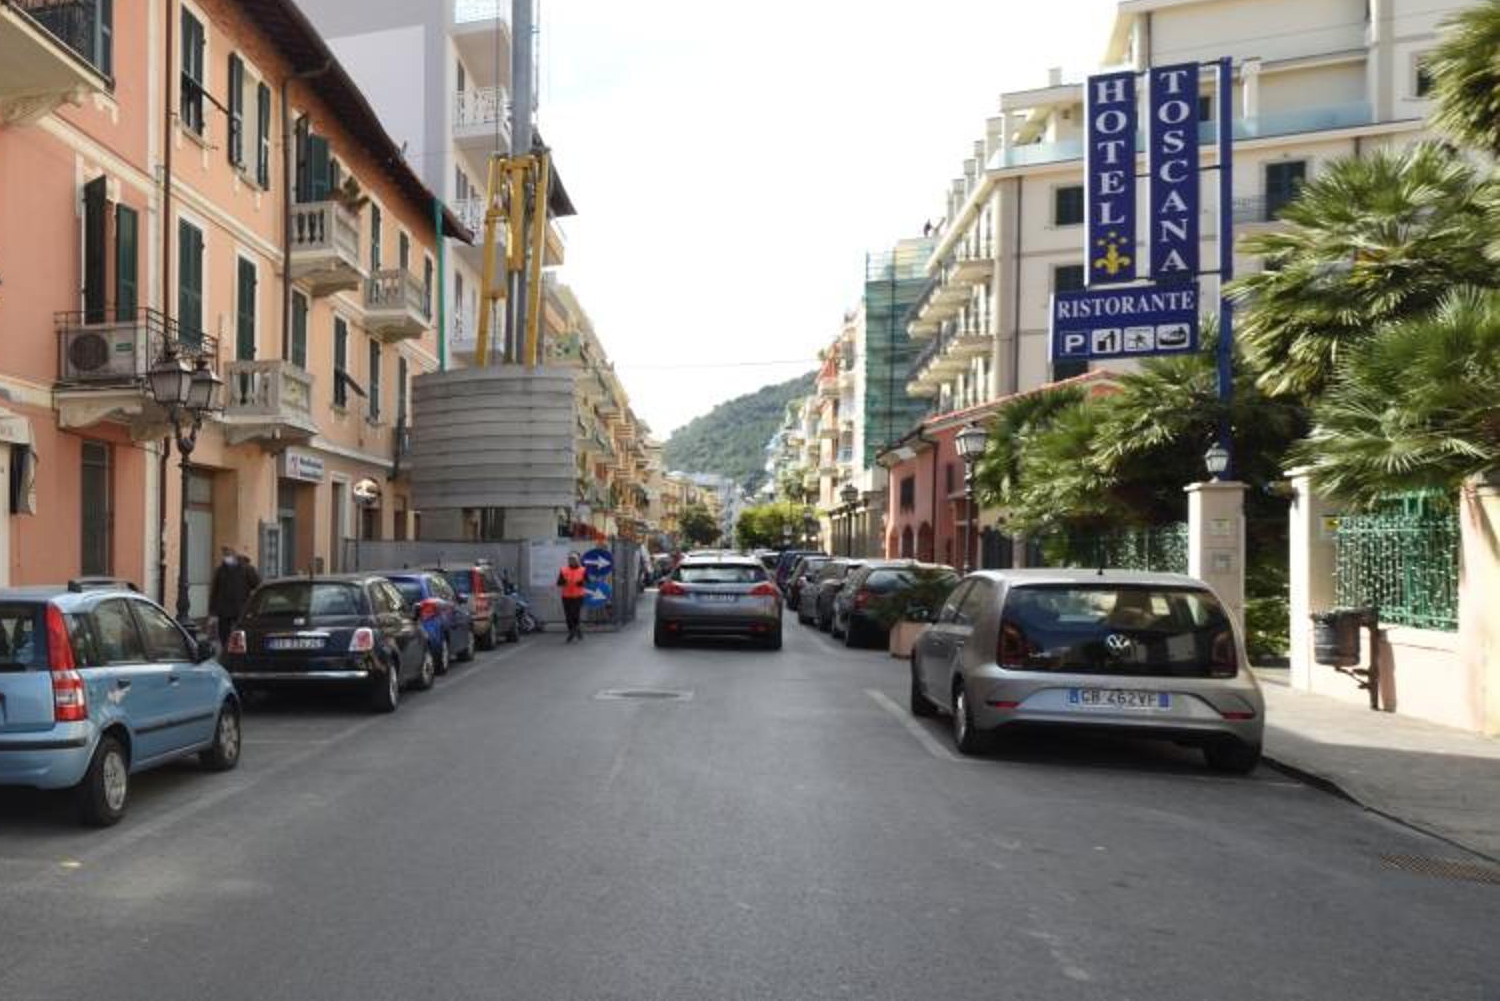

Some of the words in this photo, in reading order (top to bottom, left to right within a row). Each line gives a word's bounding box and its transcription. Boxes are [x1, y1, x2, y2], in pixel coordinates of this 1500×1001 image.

[1095, 77, 1128, 225] HOTEL
[1157, 69, 1191, 273] TOSCANA
[1057, 290, 1195, 319] RISTORANTE
[1064, 334, 1085, 354] P
